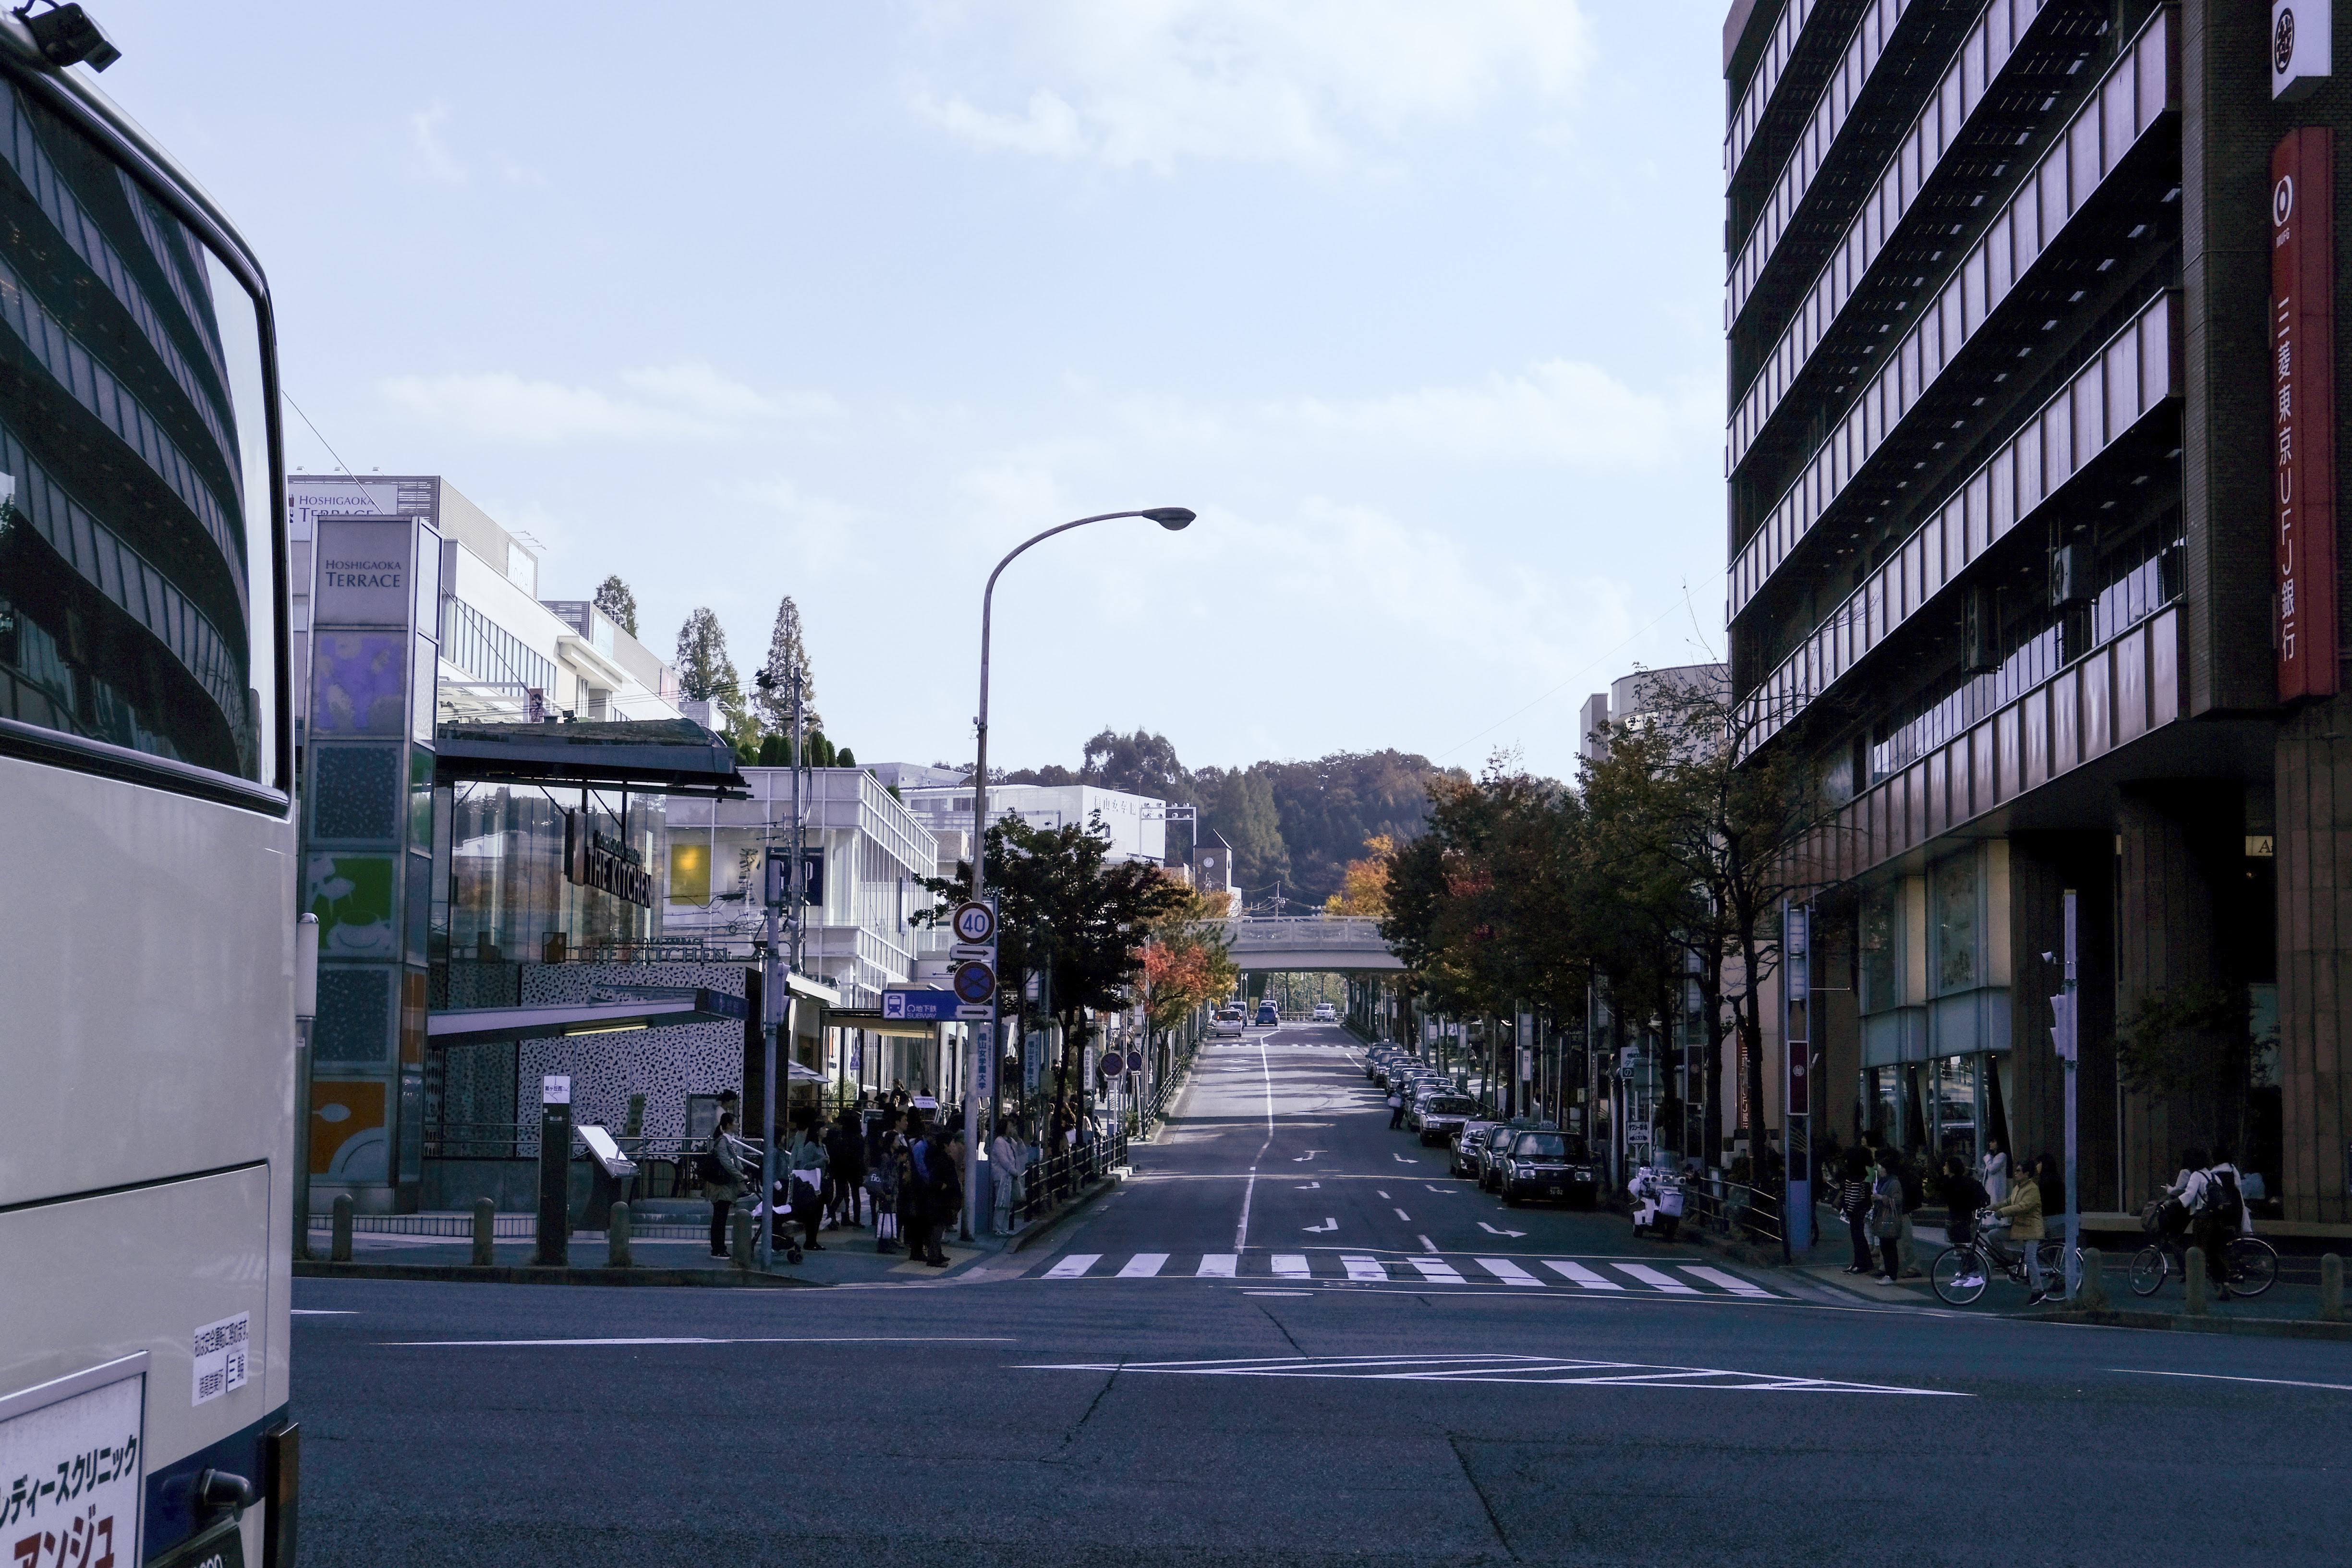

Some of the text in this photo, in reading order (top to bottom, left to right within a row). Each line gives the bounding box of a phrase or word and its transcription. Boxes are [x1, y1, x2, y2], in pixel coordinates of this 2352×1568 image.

[2278, 296, 2295, 662] 三菱東京UFJ銀行
[299, 496, 375, 505] HOSHIGAOKA
[326, 560, 401, 570] HOSHIGAOKA
[326, 572, 400, 587] TERRACE
[611, 857, 651, 908] KITCHEN
[963, 914, 985, 933] 40
[575, 946, 727, 963] THE KITCHEN
